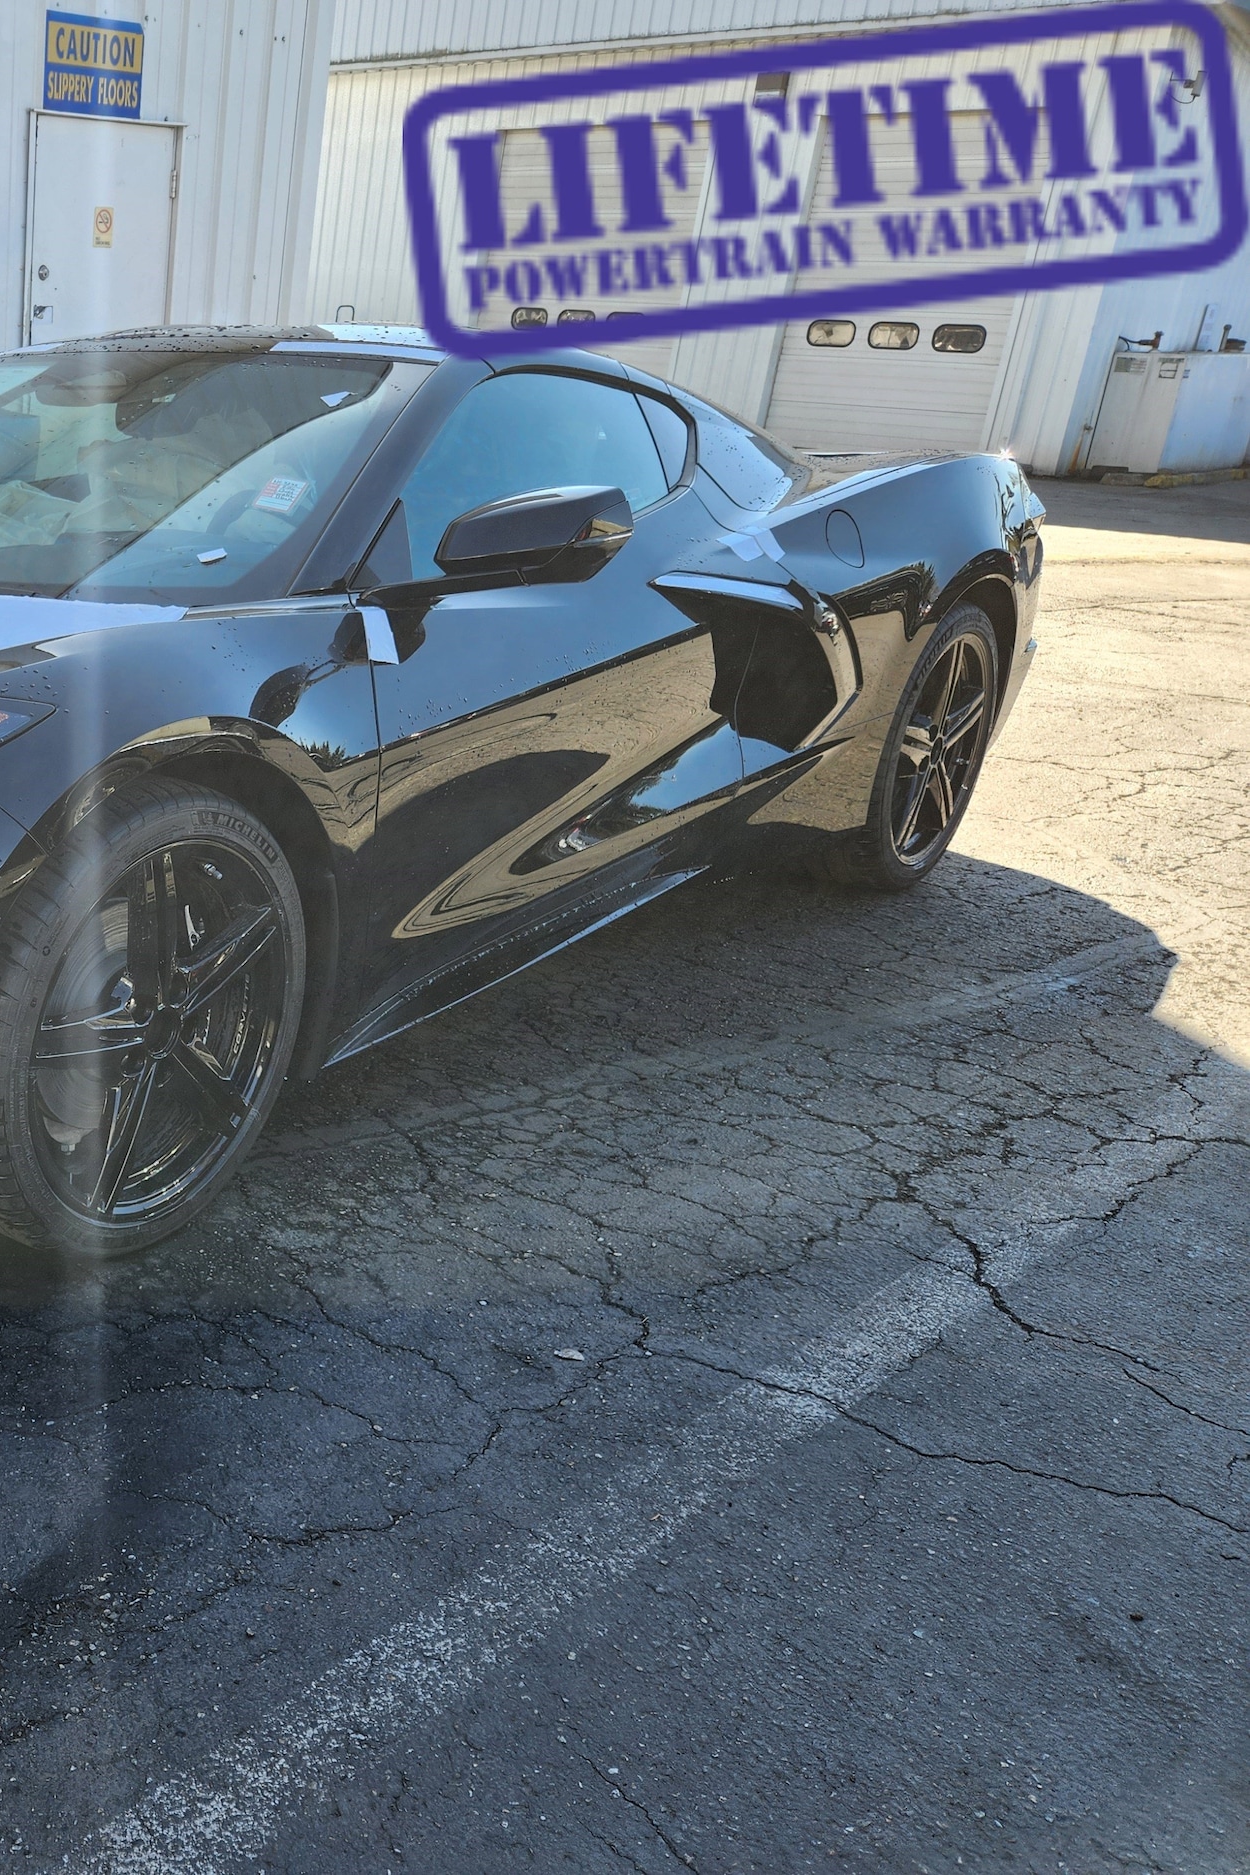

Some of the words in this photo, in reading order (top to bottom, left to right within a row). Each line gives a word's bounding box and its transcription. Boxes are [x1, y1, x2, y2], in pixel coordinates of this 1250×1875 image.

[56, 27, 136, 68] CAUTION
[47, 71, 95, 103] SLIPPERY
[98, 77, 139, 108] FLOORS
[216, 813, 276, 859] MICHELIN
[233, 973, 250, 1054] CORVETTE
